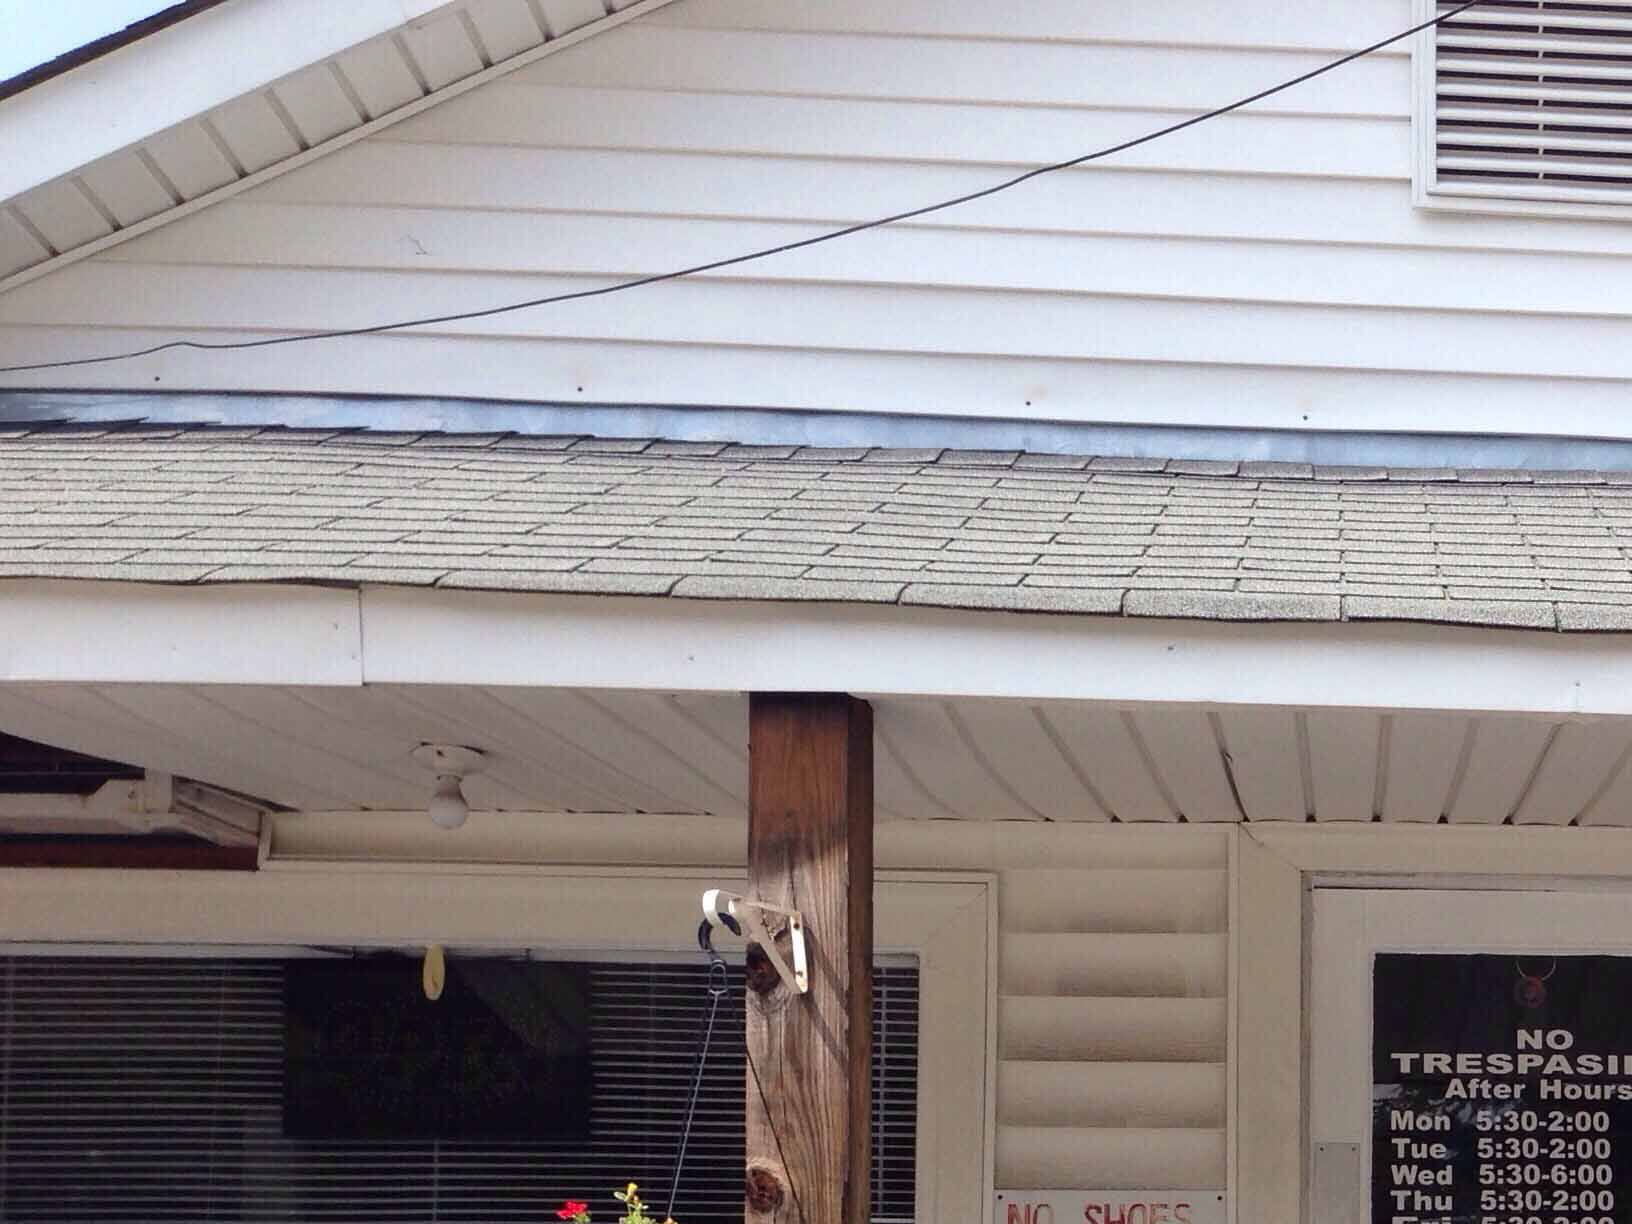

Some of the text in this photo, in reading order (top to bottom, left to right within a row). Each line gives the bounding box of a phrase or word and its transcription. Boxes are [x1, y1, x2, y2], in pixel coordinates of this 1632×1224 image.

[1516, 1029, 1574, 1050] NO
[1445, 1078, 1526, 1100] After
[1390, 1110, 1451, 1132] Mon
[1475, 1111, 1610, 1133] 5:30-2:00
[1391, 1138, 1448, 1159] Tue
[1477, 1138, 1611, 1160] 5:30-2:00
[1390, 1165, 1453, 1186] Wed
[1479, 1165, 1613, 1186] 5:30-6:00
[1390, 1190, 1454, 1212] Thu
[1480, 1190, 1614, 1212] 5:30-2:00
